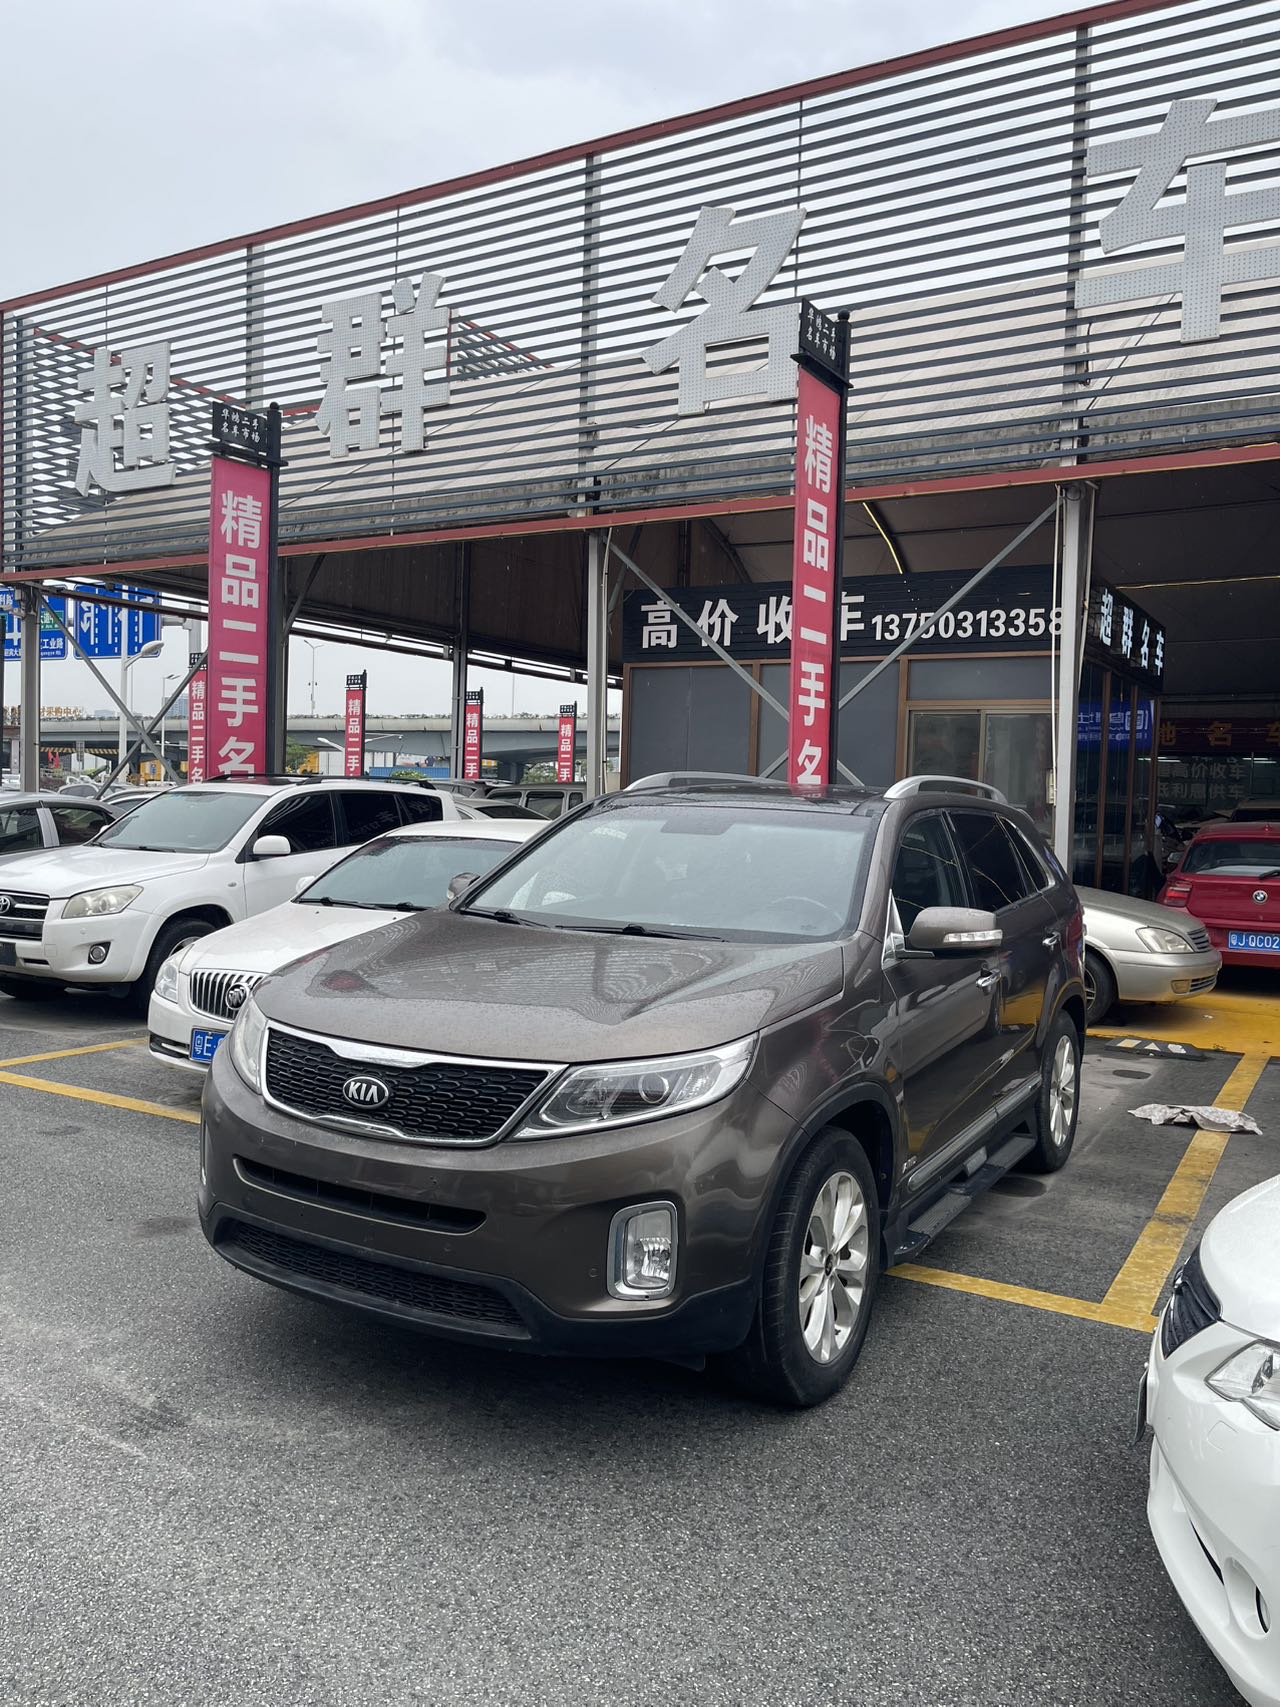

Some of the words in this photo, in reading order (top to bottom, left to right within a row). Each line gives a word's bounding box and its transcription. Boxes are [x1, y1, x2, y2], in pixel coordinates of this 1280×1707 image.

[41, 638, 63, 649] 工业路
[872, 608, 1064, 641] 13750313358
[1100, 588, 1165, 676] 超群名车
[465, 713, 478, 777] 精品二手
[560, 724, 571, 781] 精品二手
[348, 1081, 379, 1103] KIA
